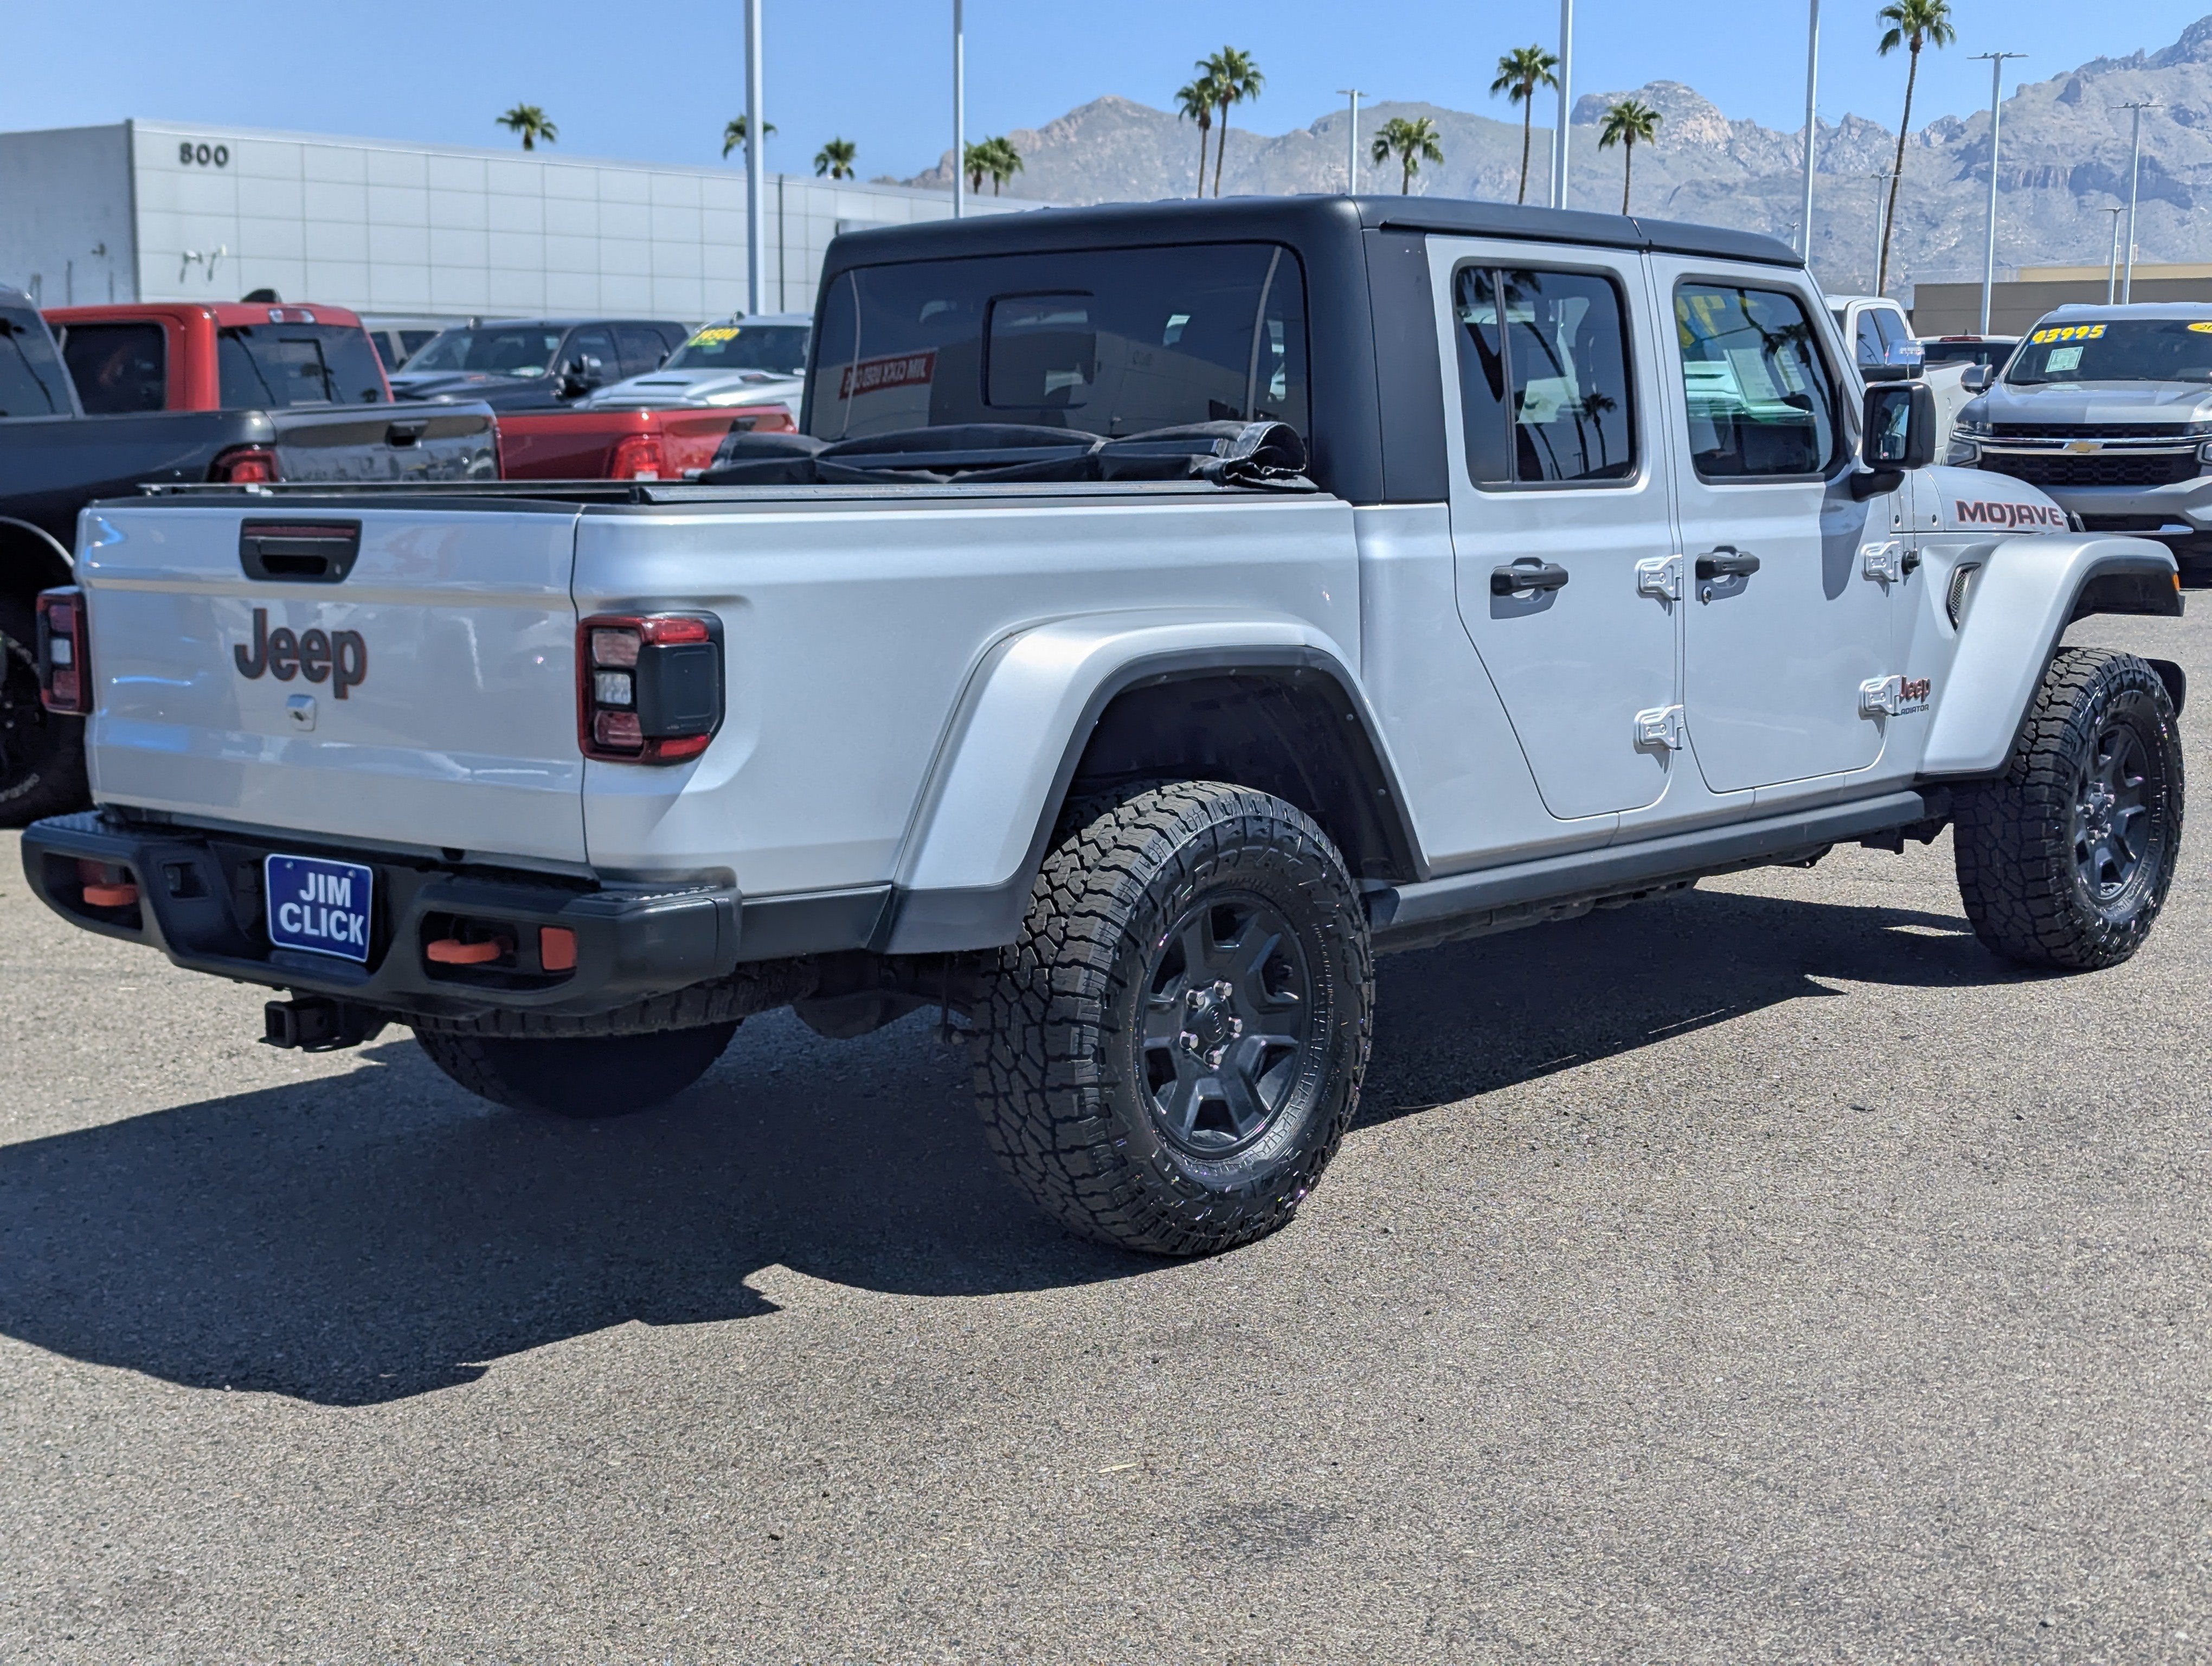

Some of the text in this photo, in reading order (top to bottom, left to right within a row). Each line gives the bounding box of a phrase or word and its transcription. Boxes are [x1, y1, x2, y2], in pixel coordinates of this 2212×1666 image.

[179, 142, 229, 169] 800
[1955, 500, 2065, 528] MOJAVE
[234, 607, 367, 700] Jeep
[1899, 675, 1931, 704] Jeep
[299, 872, 351, 908] JIM
[279, 902, 365, 946] CLICK
